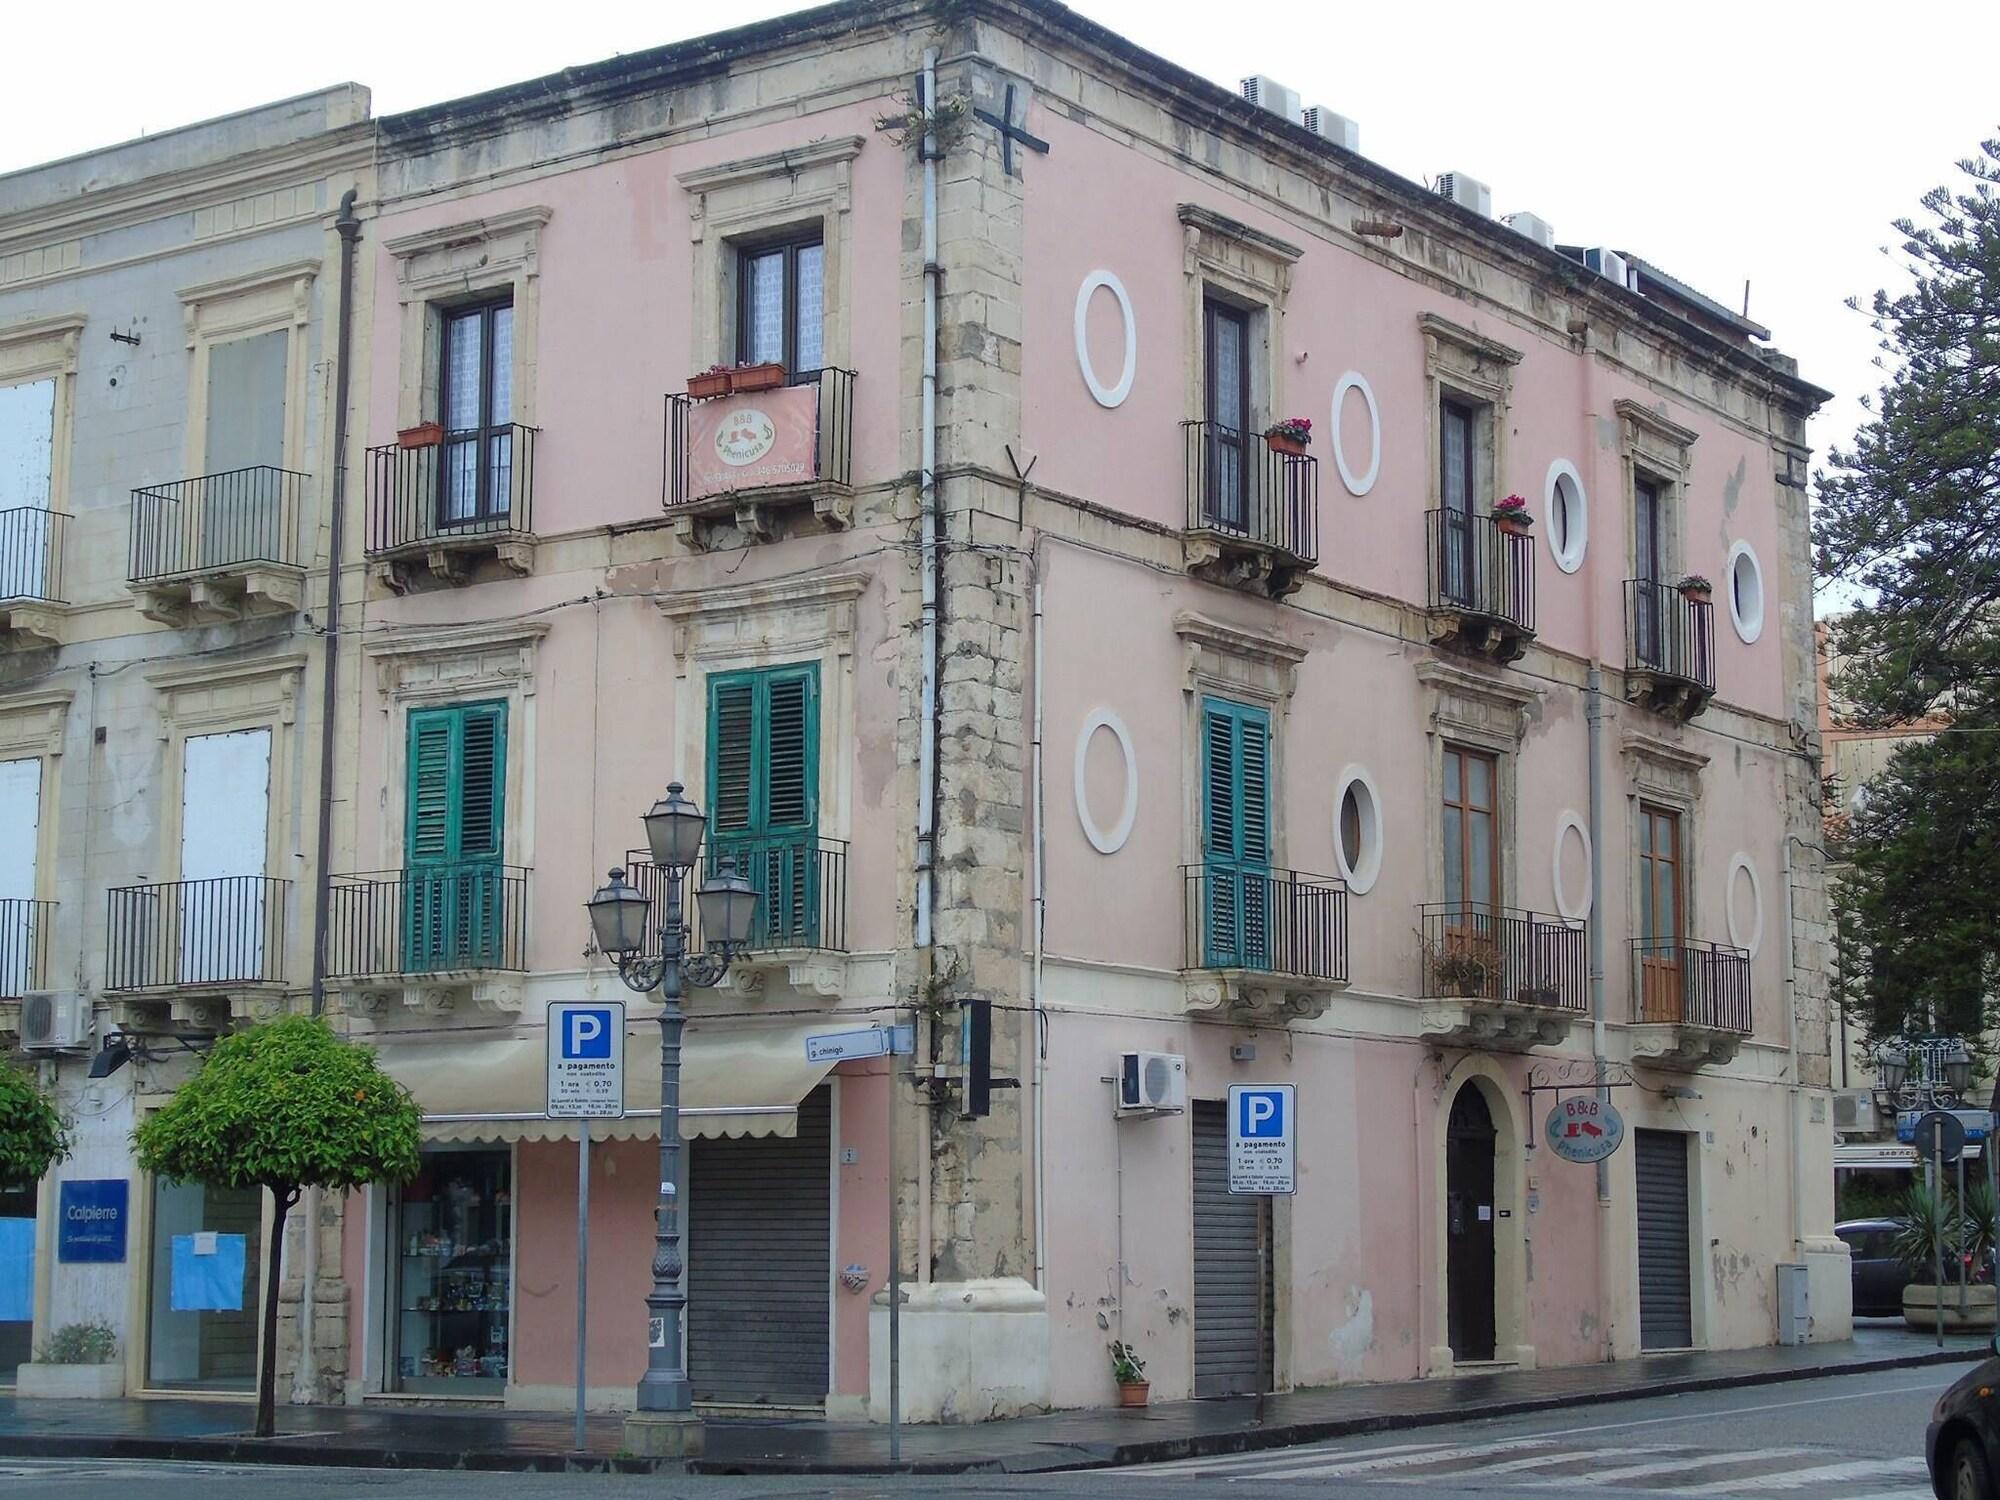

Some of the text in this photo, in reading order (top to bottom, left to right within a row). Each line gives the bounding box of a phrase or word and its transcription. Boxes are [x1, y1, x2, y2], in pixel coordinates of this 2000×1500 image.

[571, 1014, 601, 1055] P
[567, 1062, 616, 1071] pagamento
[1248, 1096, 1275, 1134] P
[1566, 1100, 1599, 1117] B&B
[1243, 1141, 1286, 1149] pagamento
[1557, 1140, 1613, 1158] Phenicusa
[67, 1204, 118, 1224] Calpierre
